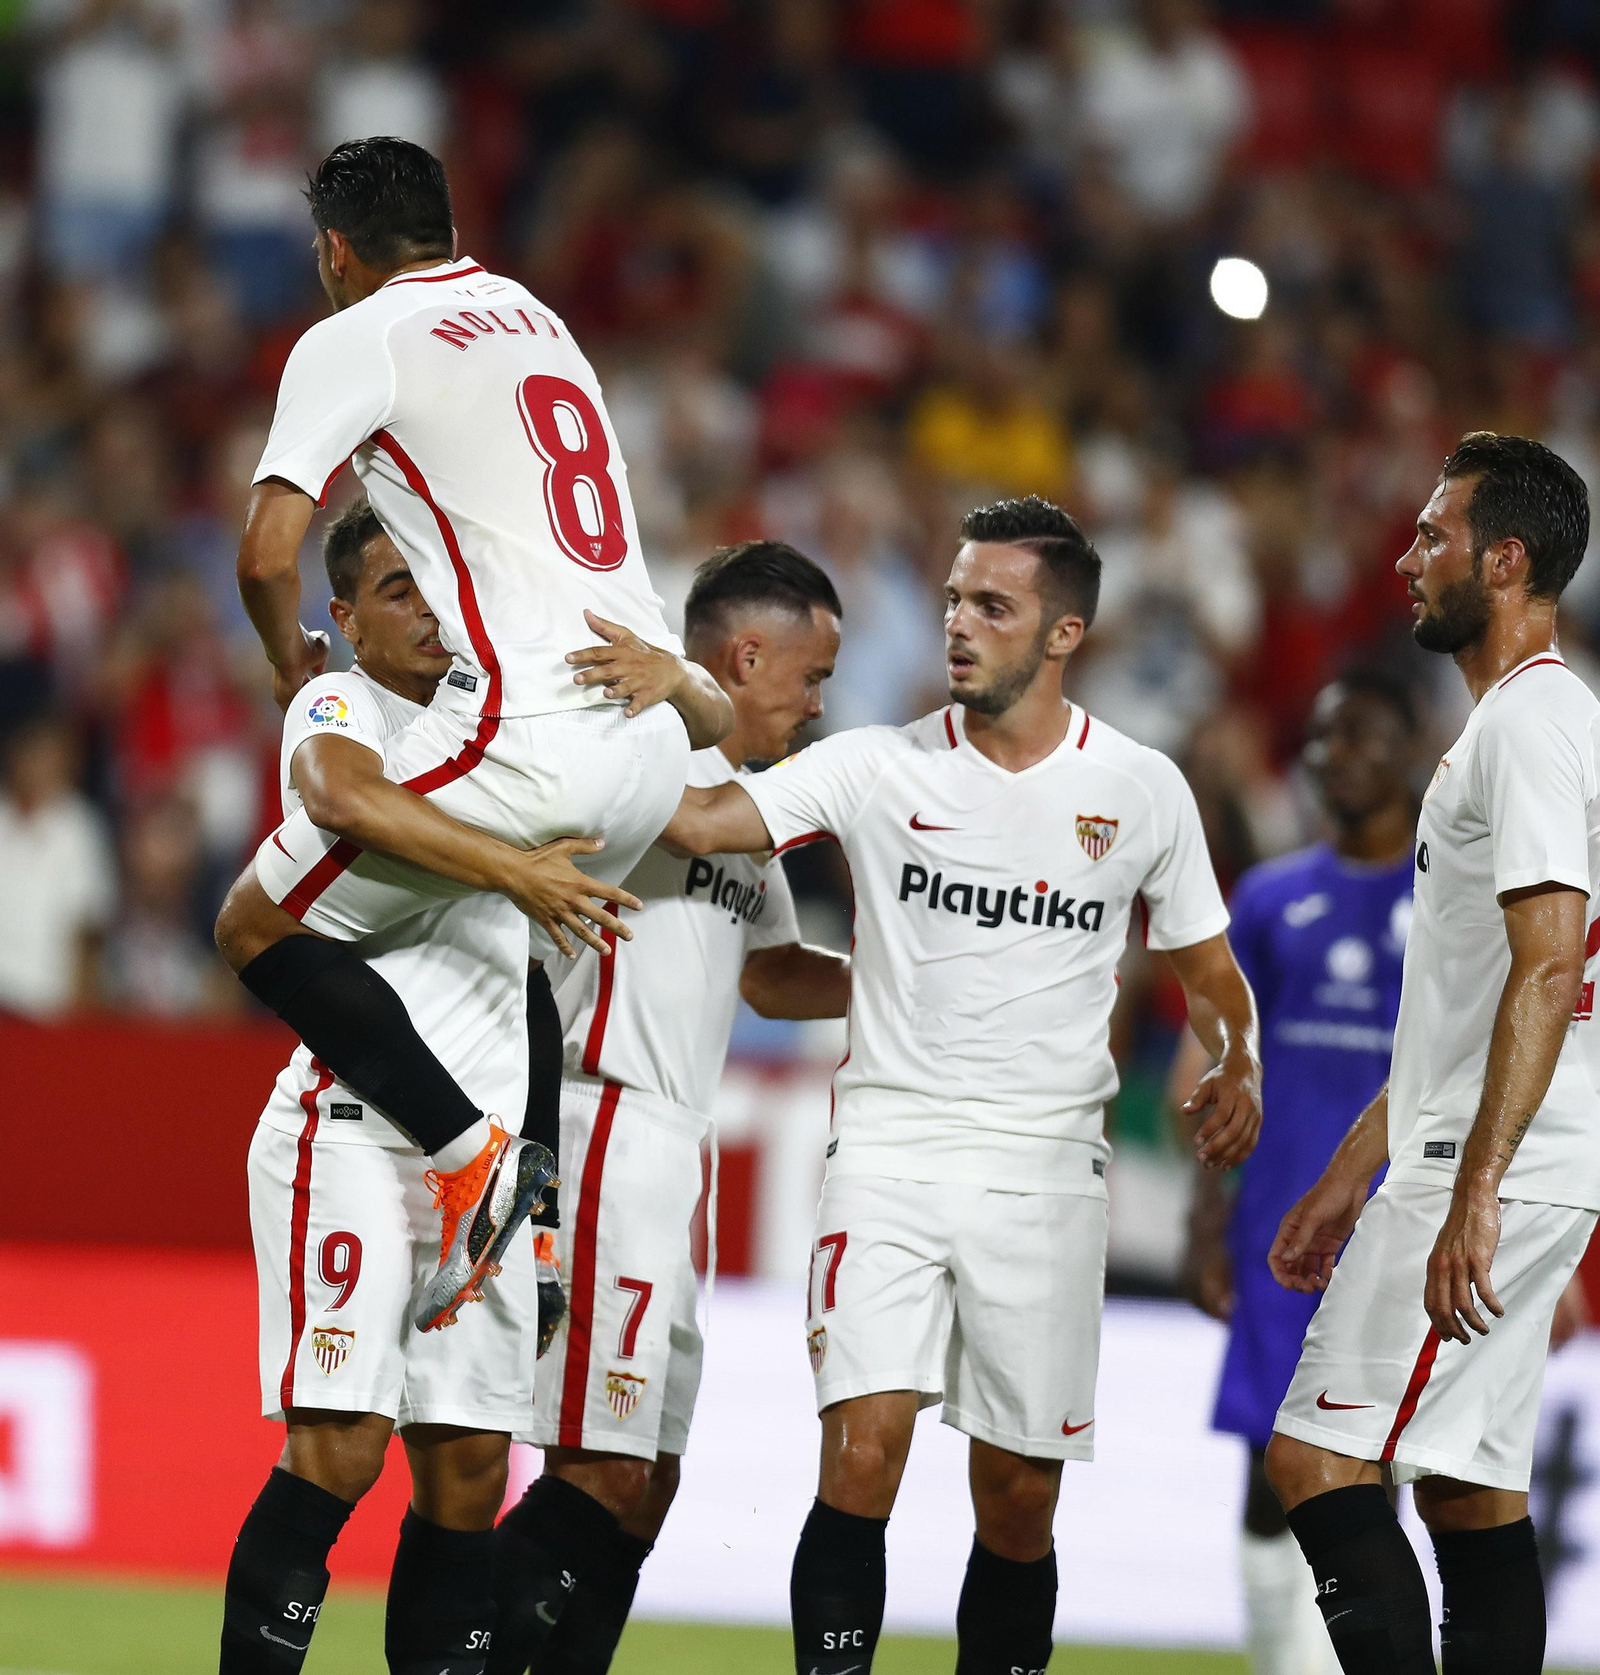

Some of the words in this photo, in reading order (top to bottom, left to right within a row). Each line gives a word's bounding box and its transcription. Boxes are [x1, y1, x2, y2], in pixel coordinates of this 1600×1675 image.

[429, 308, 562, 352] NOLIT
[515, 374, 628, 572] 8
[685, 856, 767, 925] Playti
[899, 863, 1105, 932] Playtika
[317, 1231, 363, 1312] 9
[613, 1275, 654, 1360] 7
[823, 1629, 864, 1650] SFC
